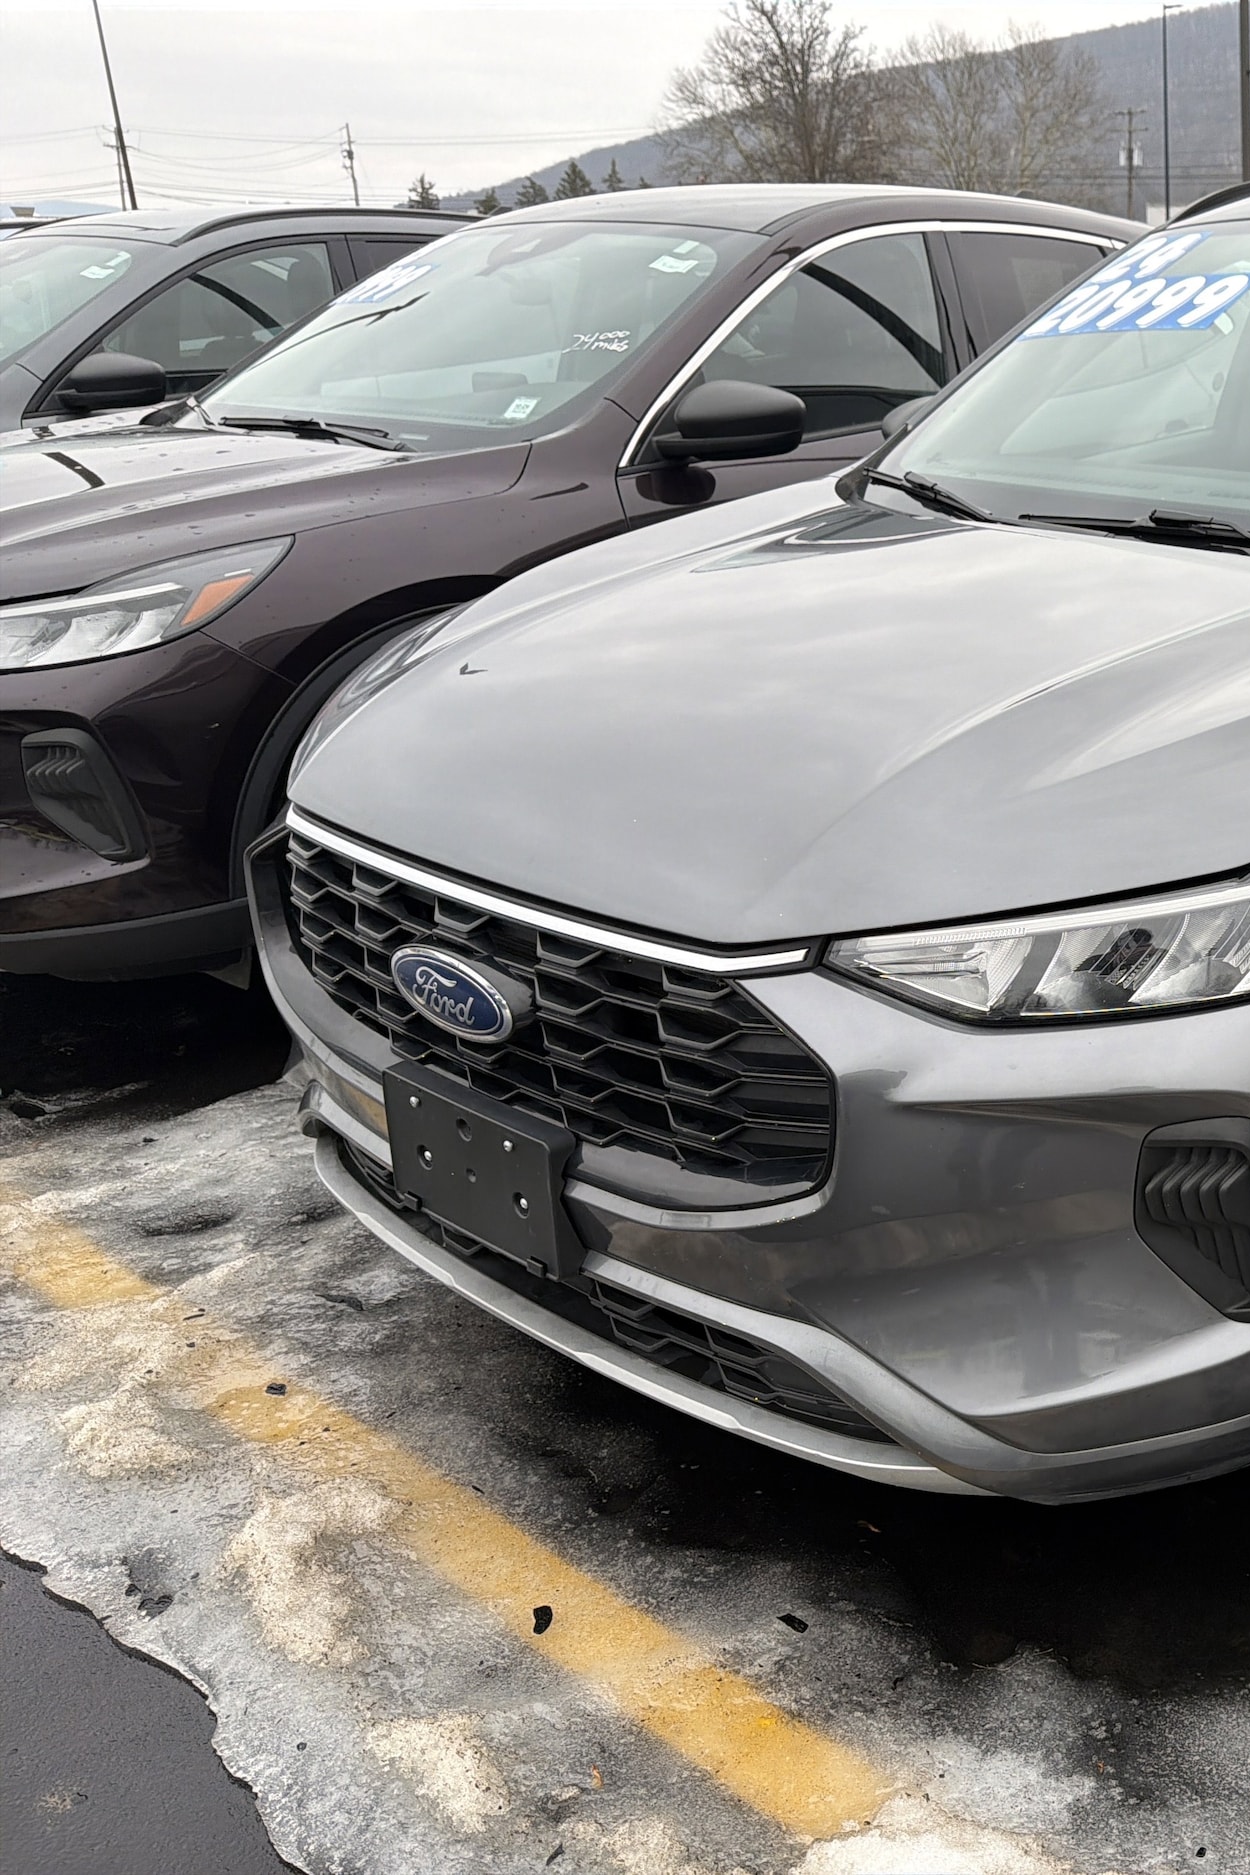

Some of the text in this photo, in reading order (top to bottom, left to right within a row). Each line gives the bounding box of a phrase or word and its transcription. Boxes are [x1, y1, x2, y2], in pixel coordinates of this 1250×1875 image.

[1088, 232, 1202, 283] 24
[1021, 274, 1250, 337] 20999
[412, 965, 475, 1026] Ford
